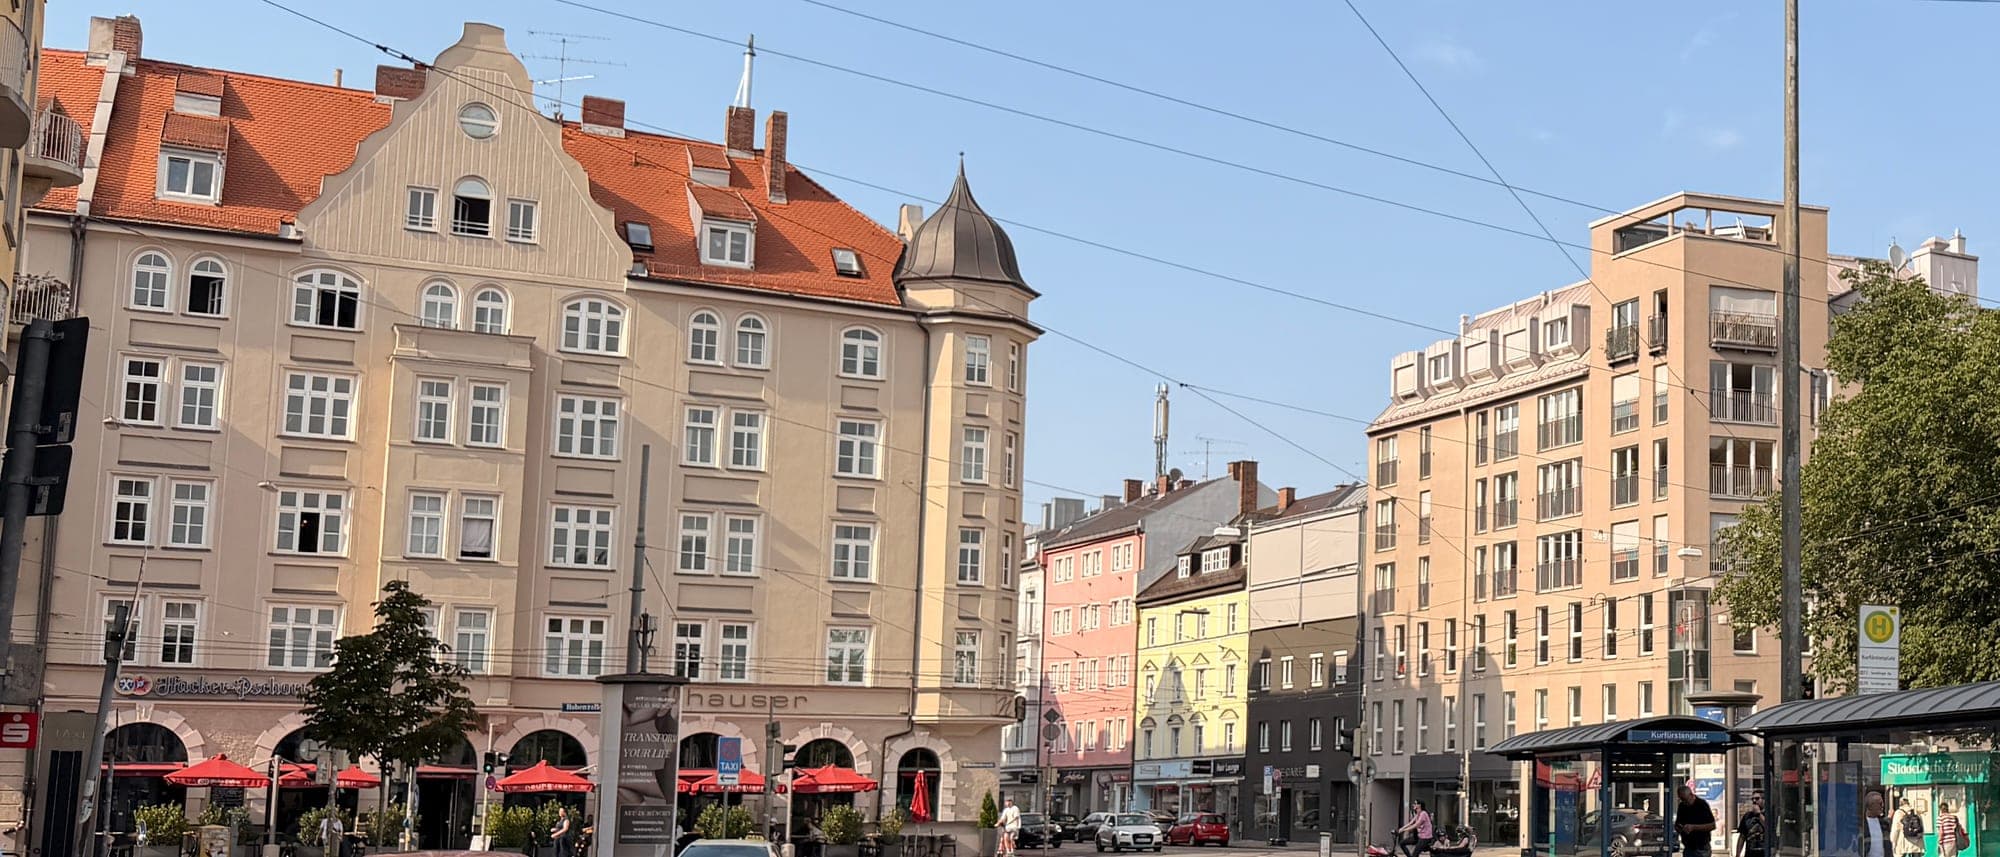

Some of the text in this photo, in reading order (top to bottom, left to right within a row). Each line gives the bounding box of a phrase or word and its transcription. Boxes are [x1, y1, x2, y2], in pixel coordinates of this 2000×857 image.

[1871, 617, 1887, 636] H
[1651, 731, 1708, 740] Kurfürstenplatz
[623, 748, 671, 759] YOUR LIFE
[720, 761, 739, 771] TAXI
